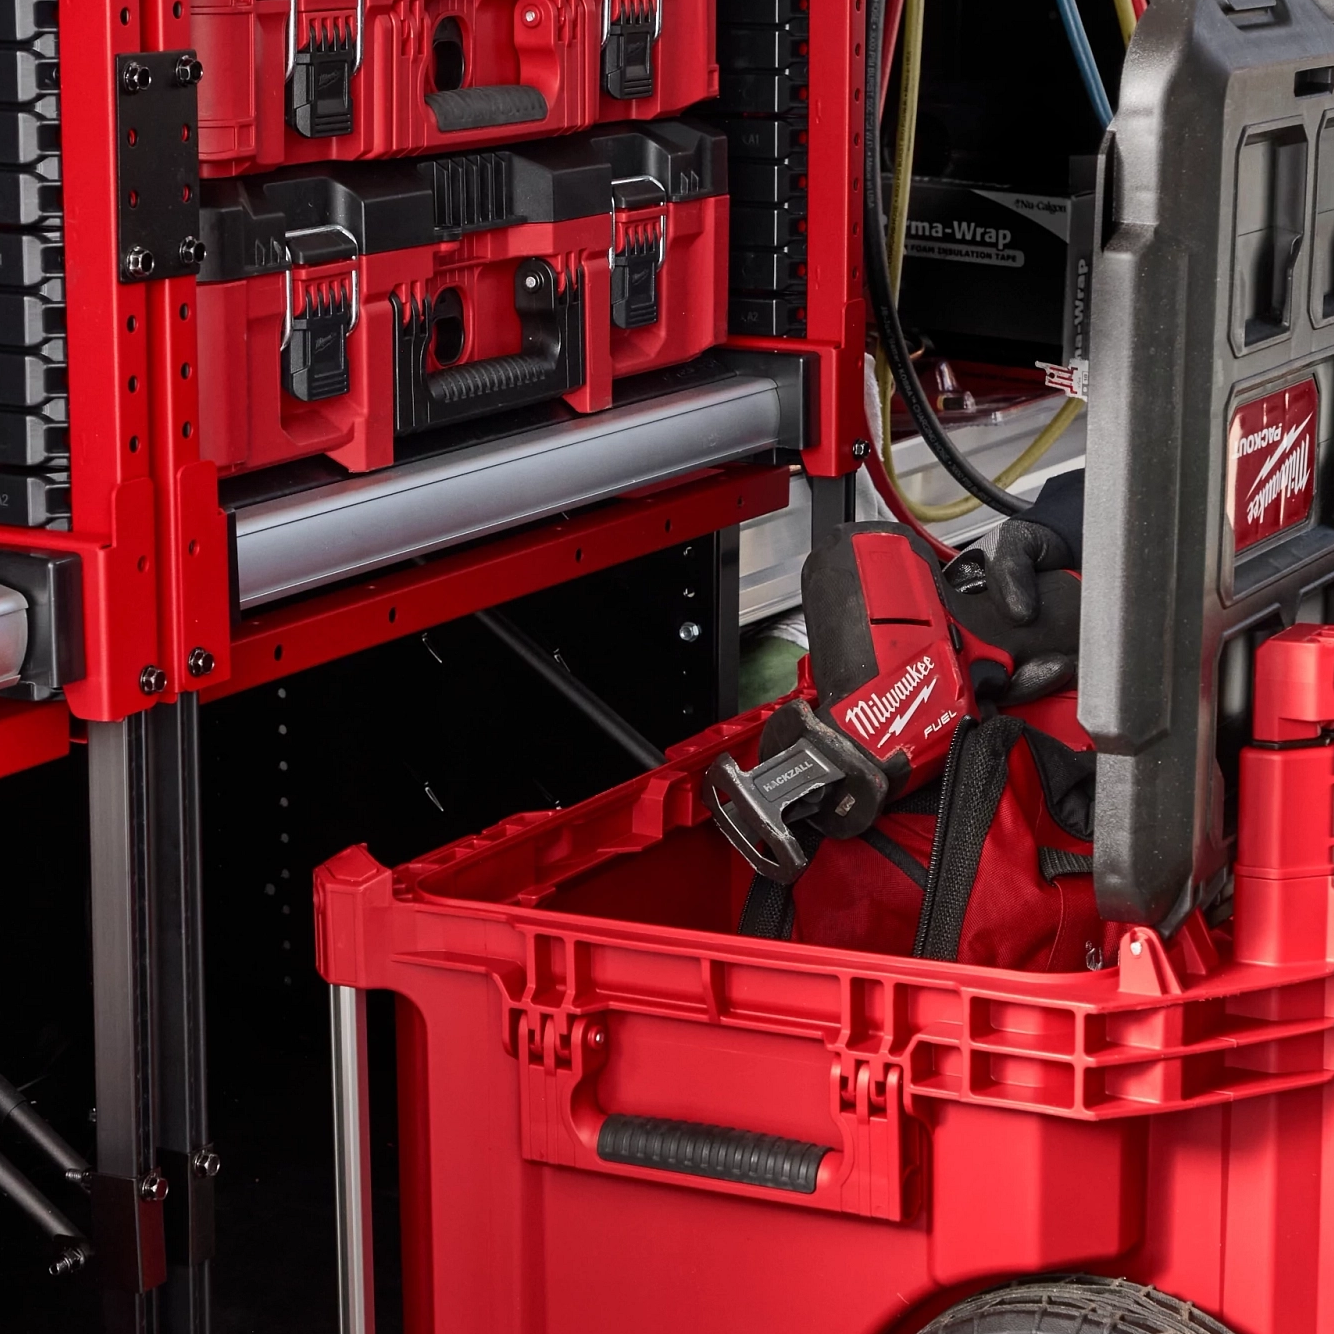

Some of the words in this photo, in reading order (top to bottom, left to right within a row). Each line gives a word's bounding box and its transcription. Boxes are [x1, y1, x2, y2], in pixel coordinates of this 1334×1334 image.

[910, 243, 935, 255] FOAM
[936, 246, 993, 261] INSULATION
[994, 251, 1017, 264] TAPE
[1232, 423, 1283, 461] PACKOUT
[1246, 433, 1311, 525] Milwaukee
[845, 655, 935, 740] Milwaukee
[923, 709, 957, 739] FUEL
[762, 760, 814, 793] HACKZALL
